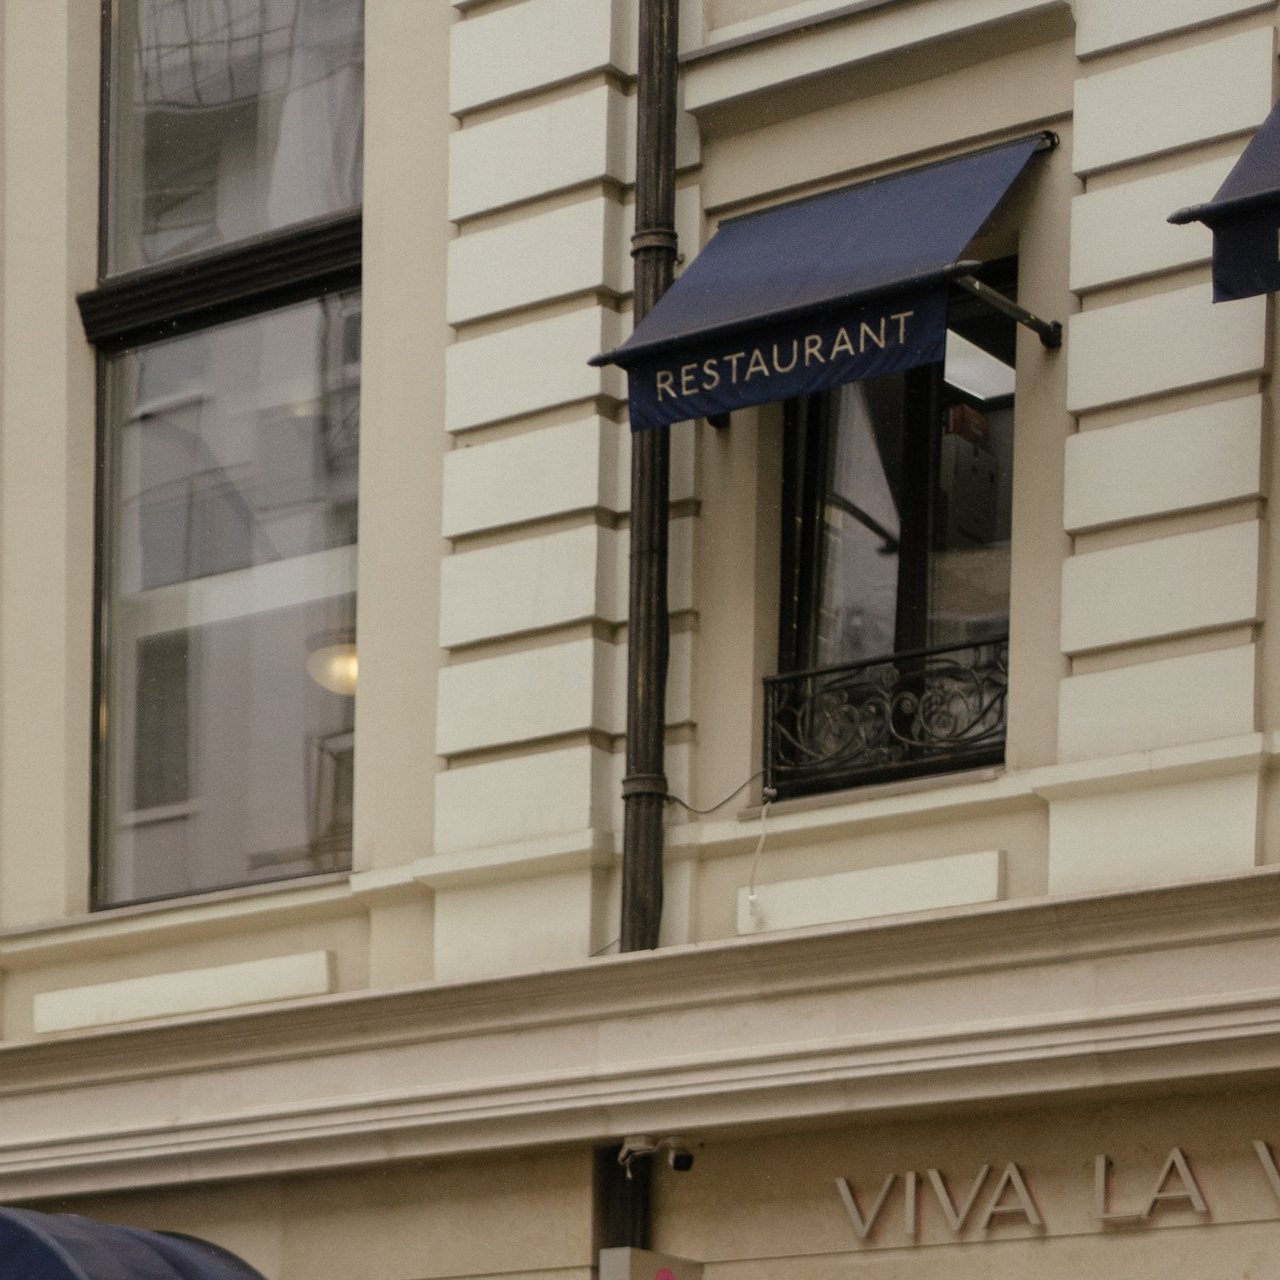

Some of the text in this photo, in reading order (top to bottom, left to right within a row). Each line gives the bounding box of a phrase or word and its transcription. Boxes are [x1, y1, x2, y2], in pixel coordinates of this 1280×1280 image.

[656, 310, 915, 401] RESTAURANT
[835, 1161, 1044, 1240] VIVA
[1093, 1147, 1210, 1222] LA
